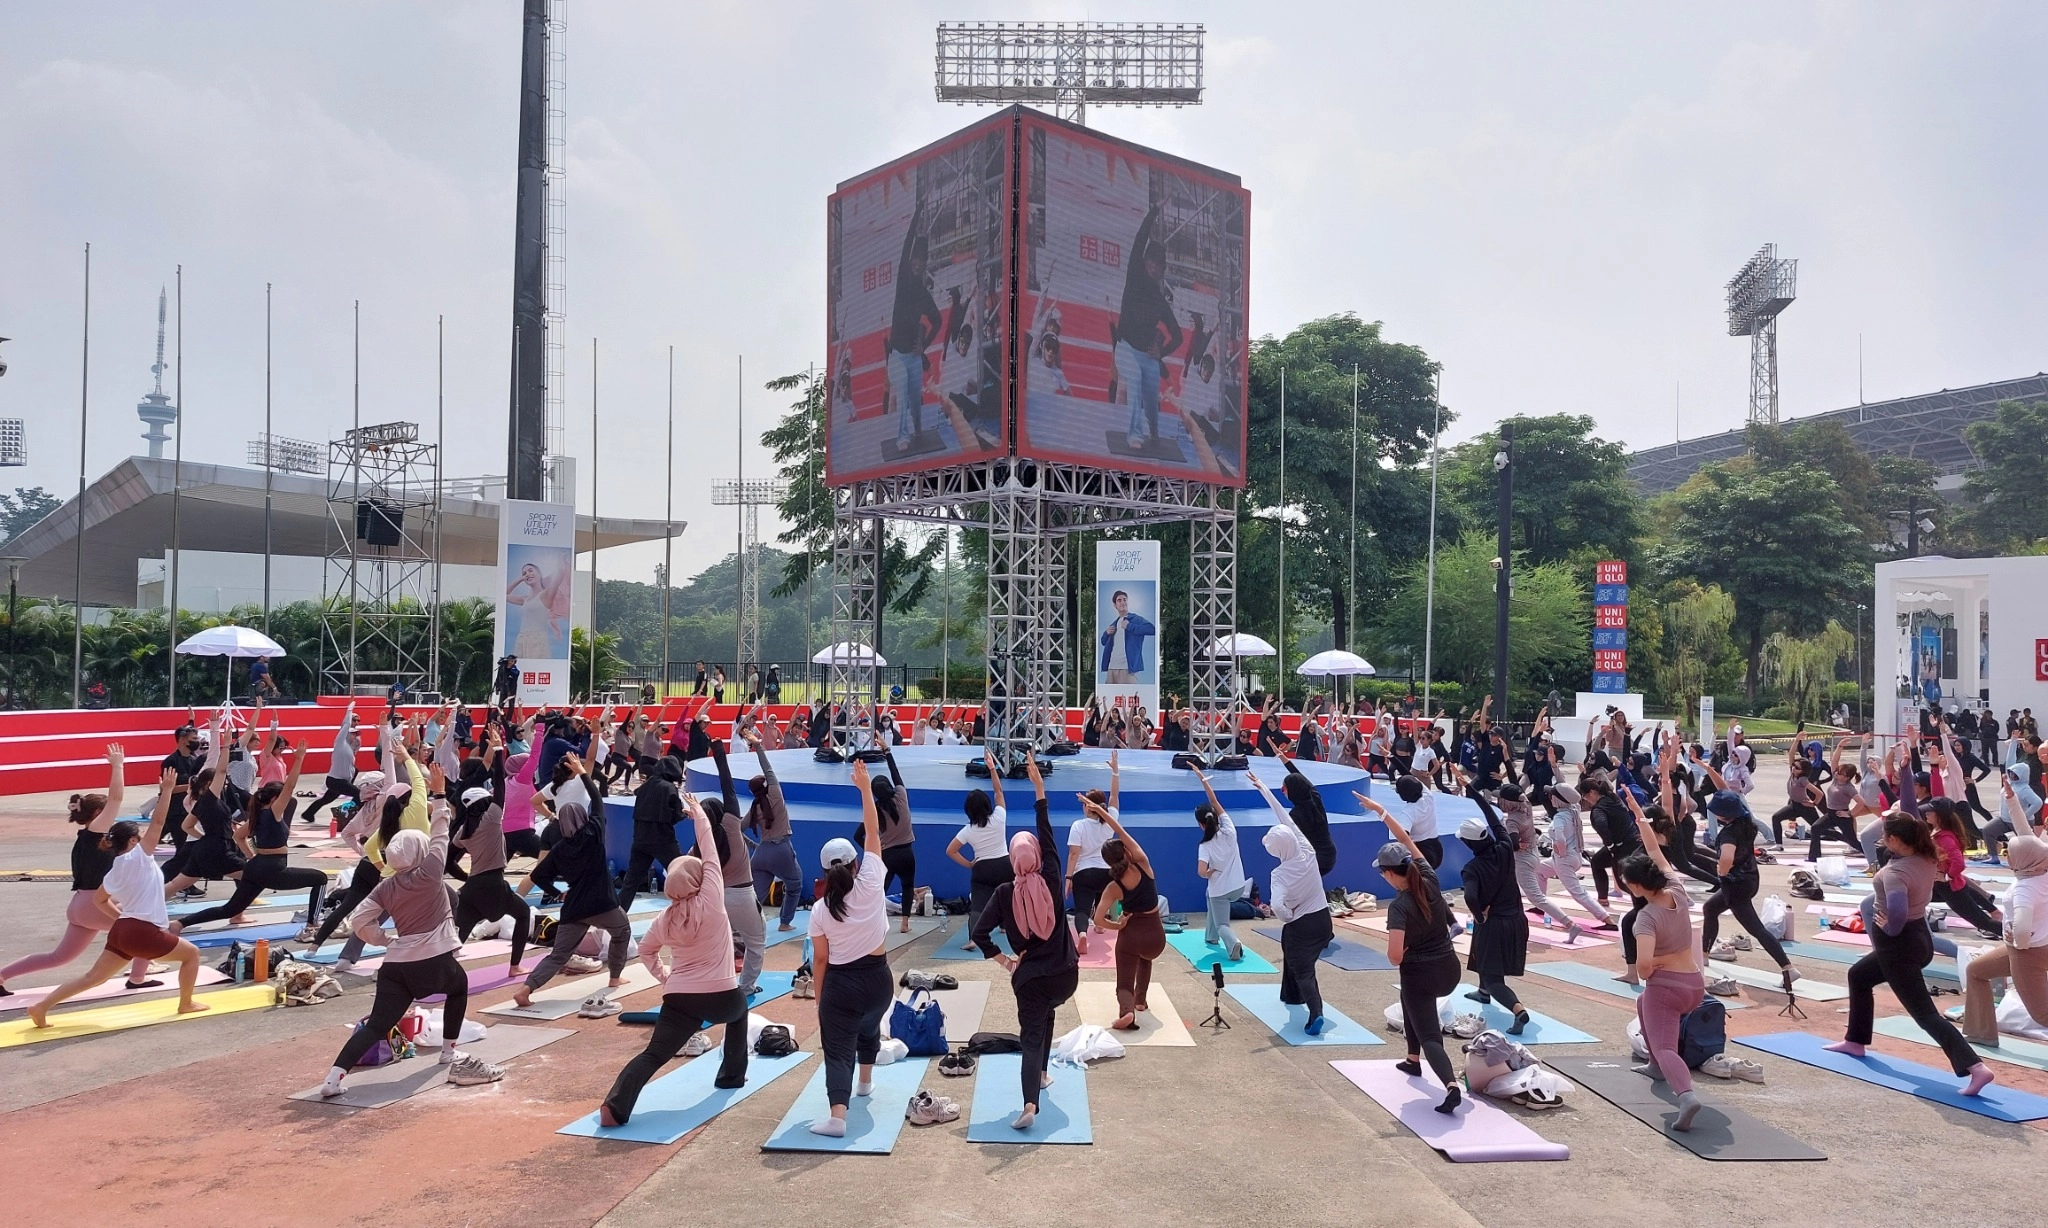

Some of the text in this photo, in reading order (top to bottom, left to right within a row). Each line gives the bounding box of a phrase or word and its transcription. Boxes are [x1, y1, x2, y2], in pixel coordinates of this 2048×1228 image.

[1104, 243, 1118, 256] UNI
[1104, 253, 1118, 265] QLO
[528, 512, 557, 522] SPORT
[526, 520, 558, 529] UTILITY
[524, 528, 549, 536] WEAR
[1604, 564, 1622, 572] UNI
[1604, 573, 1624, 582] QLO
[1604, 608, 1622, 616] UNI
[1604, 617, 1624, 626] QLO
[1604, 652, 1621, 660] UNI
[1604, 661, 1623, 670] QLO
